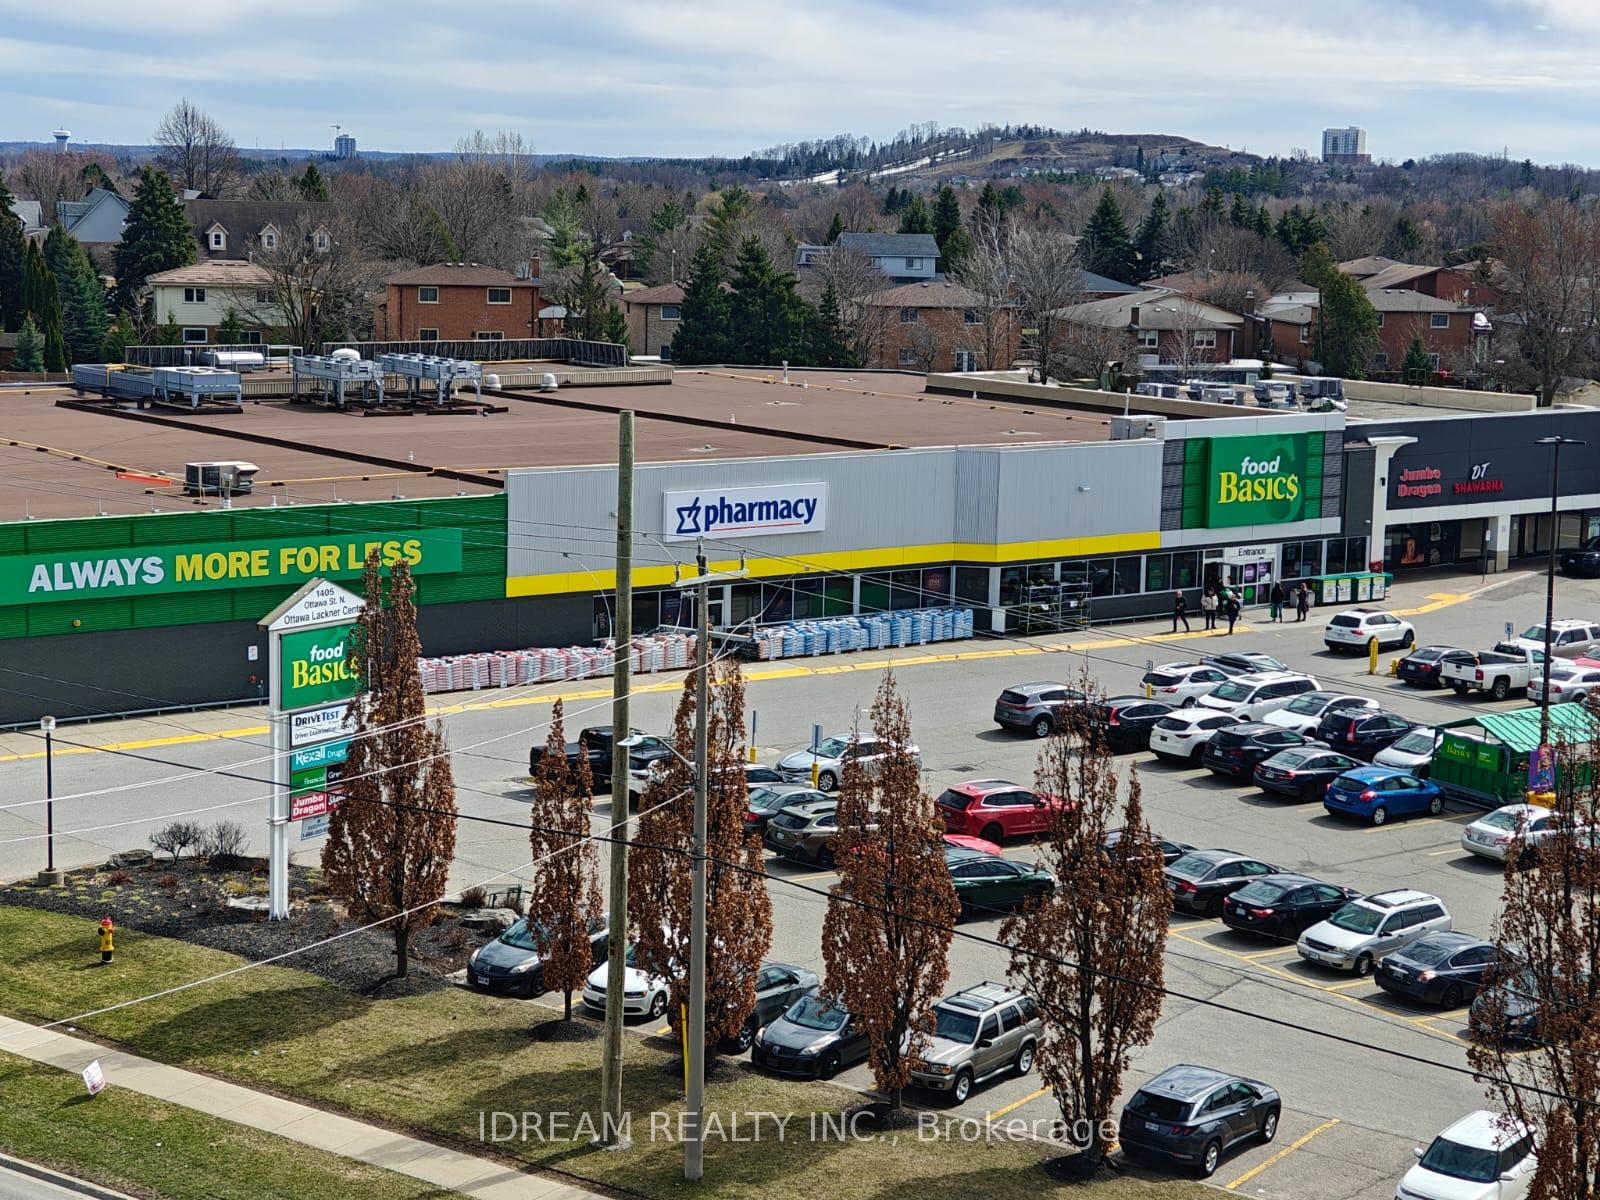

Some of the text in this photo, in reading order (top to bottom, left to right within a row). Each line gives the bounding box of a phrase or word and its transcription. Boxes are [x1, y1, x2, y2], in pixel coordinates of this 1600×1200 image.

[1241, 455, 1281, 476] food
[1471, 462, 1491, 480] DT
[1399, 466, 1441, 482] Jumbo
[1397, 483, 1442, 498] Dragon
[1454, 480, 1504, 495] SHAWARMA
[704, 496, 818, 532] pharmacy
[1238, 548, 1267, 557] Entrance
[28, 539, 423, 593] ALWAYS MORE FOR LESS
[316, 587, 335, 598] 1405
[304, 599, 328, 610] Ottawa
[328, 597, 338, 605] St.
[284, 613, 310, 625] Ottawa
[311, 608, 341, 621] Lackner
[310, 640, 344, 663] food
[295, 731, 309, 740] Driver
[295, 745, 326, 766] Rexall
[293, 793, 324, 808] Jumbo
[292, 802, 325, 817] Dragon
